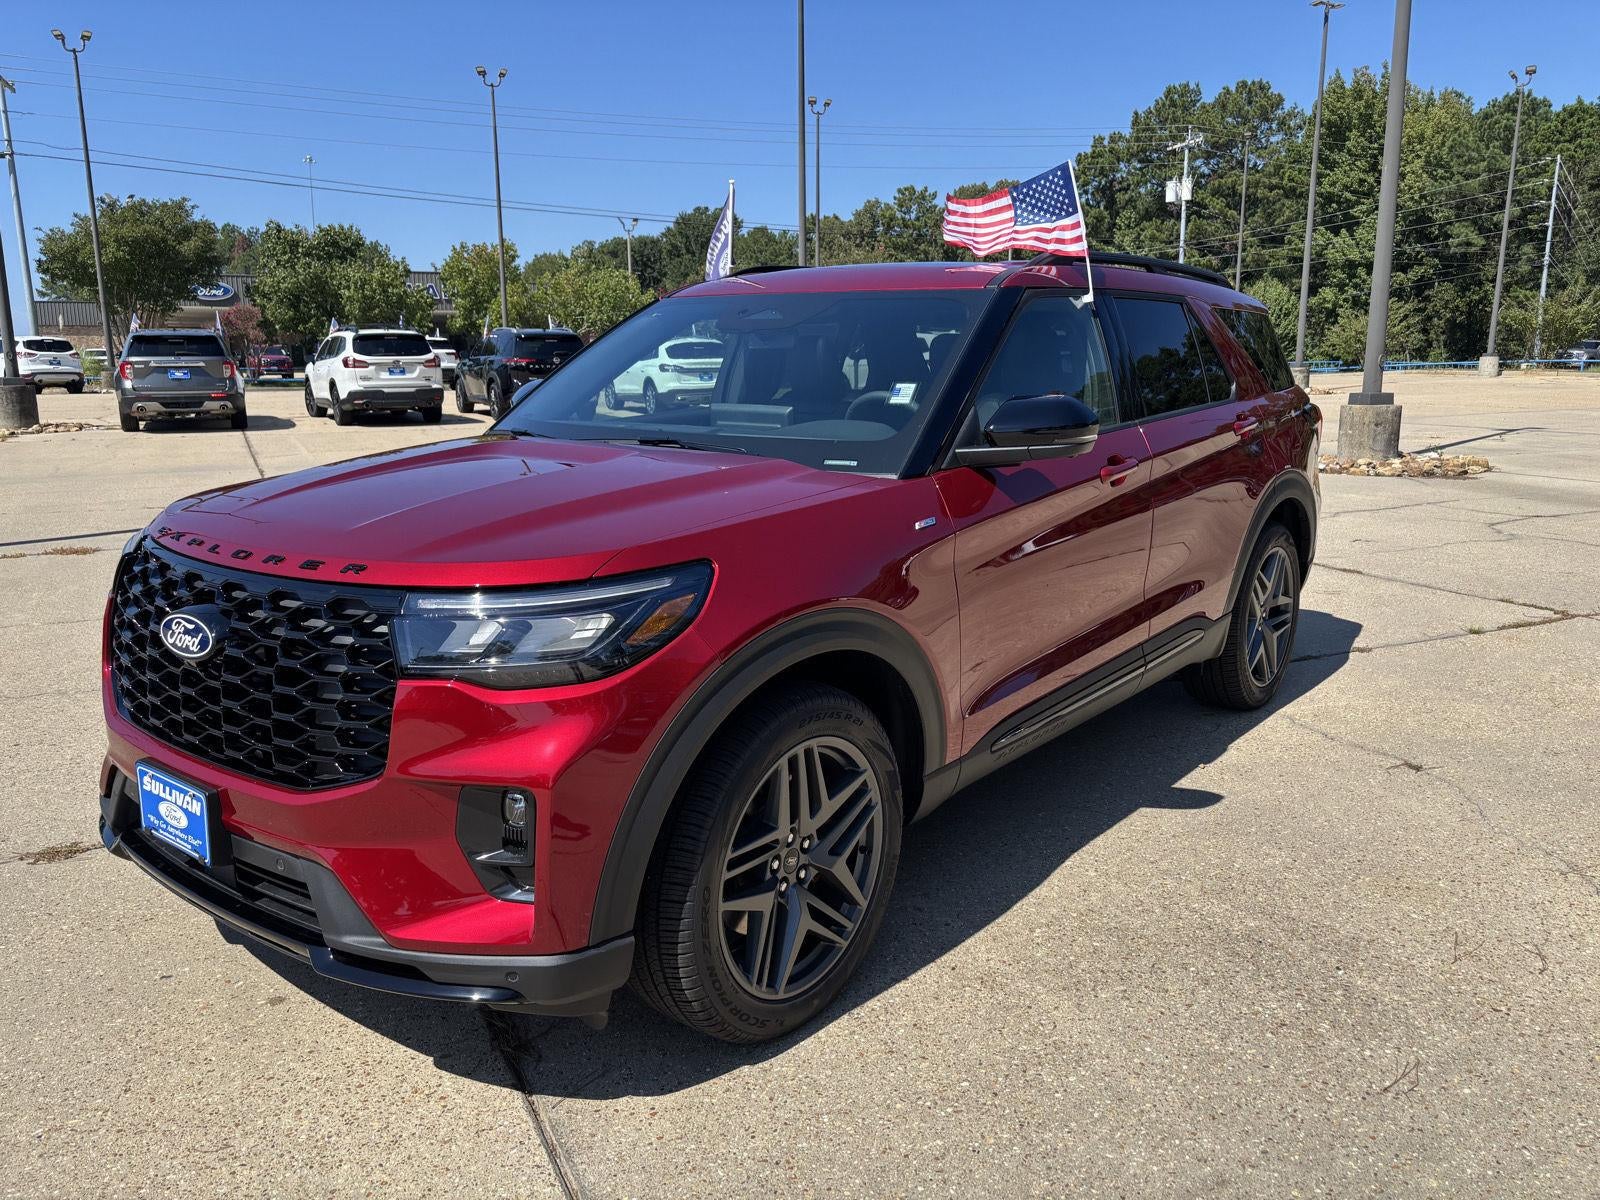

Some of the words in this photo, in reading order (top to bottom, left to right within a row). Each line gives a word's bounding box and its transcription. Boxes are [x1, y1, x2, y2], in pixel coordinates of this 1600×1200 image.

[158, 525, 369, 575] EXPLORER
[167, 618, 202, 651] Ford
[142, 774, 201, 816] SULLIVAN
[164, 805, 182, 825] Ford
[701, 887, 712, 954] ZERO
[705, 965, 770, 1029] SCORPION
